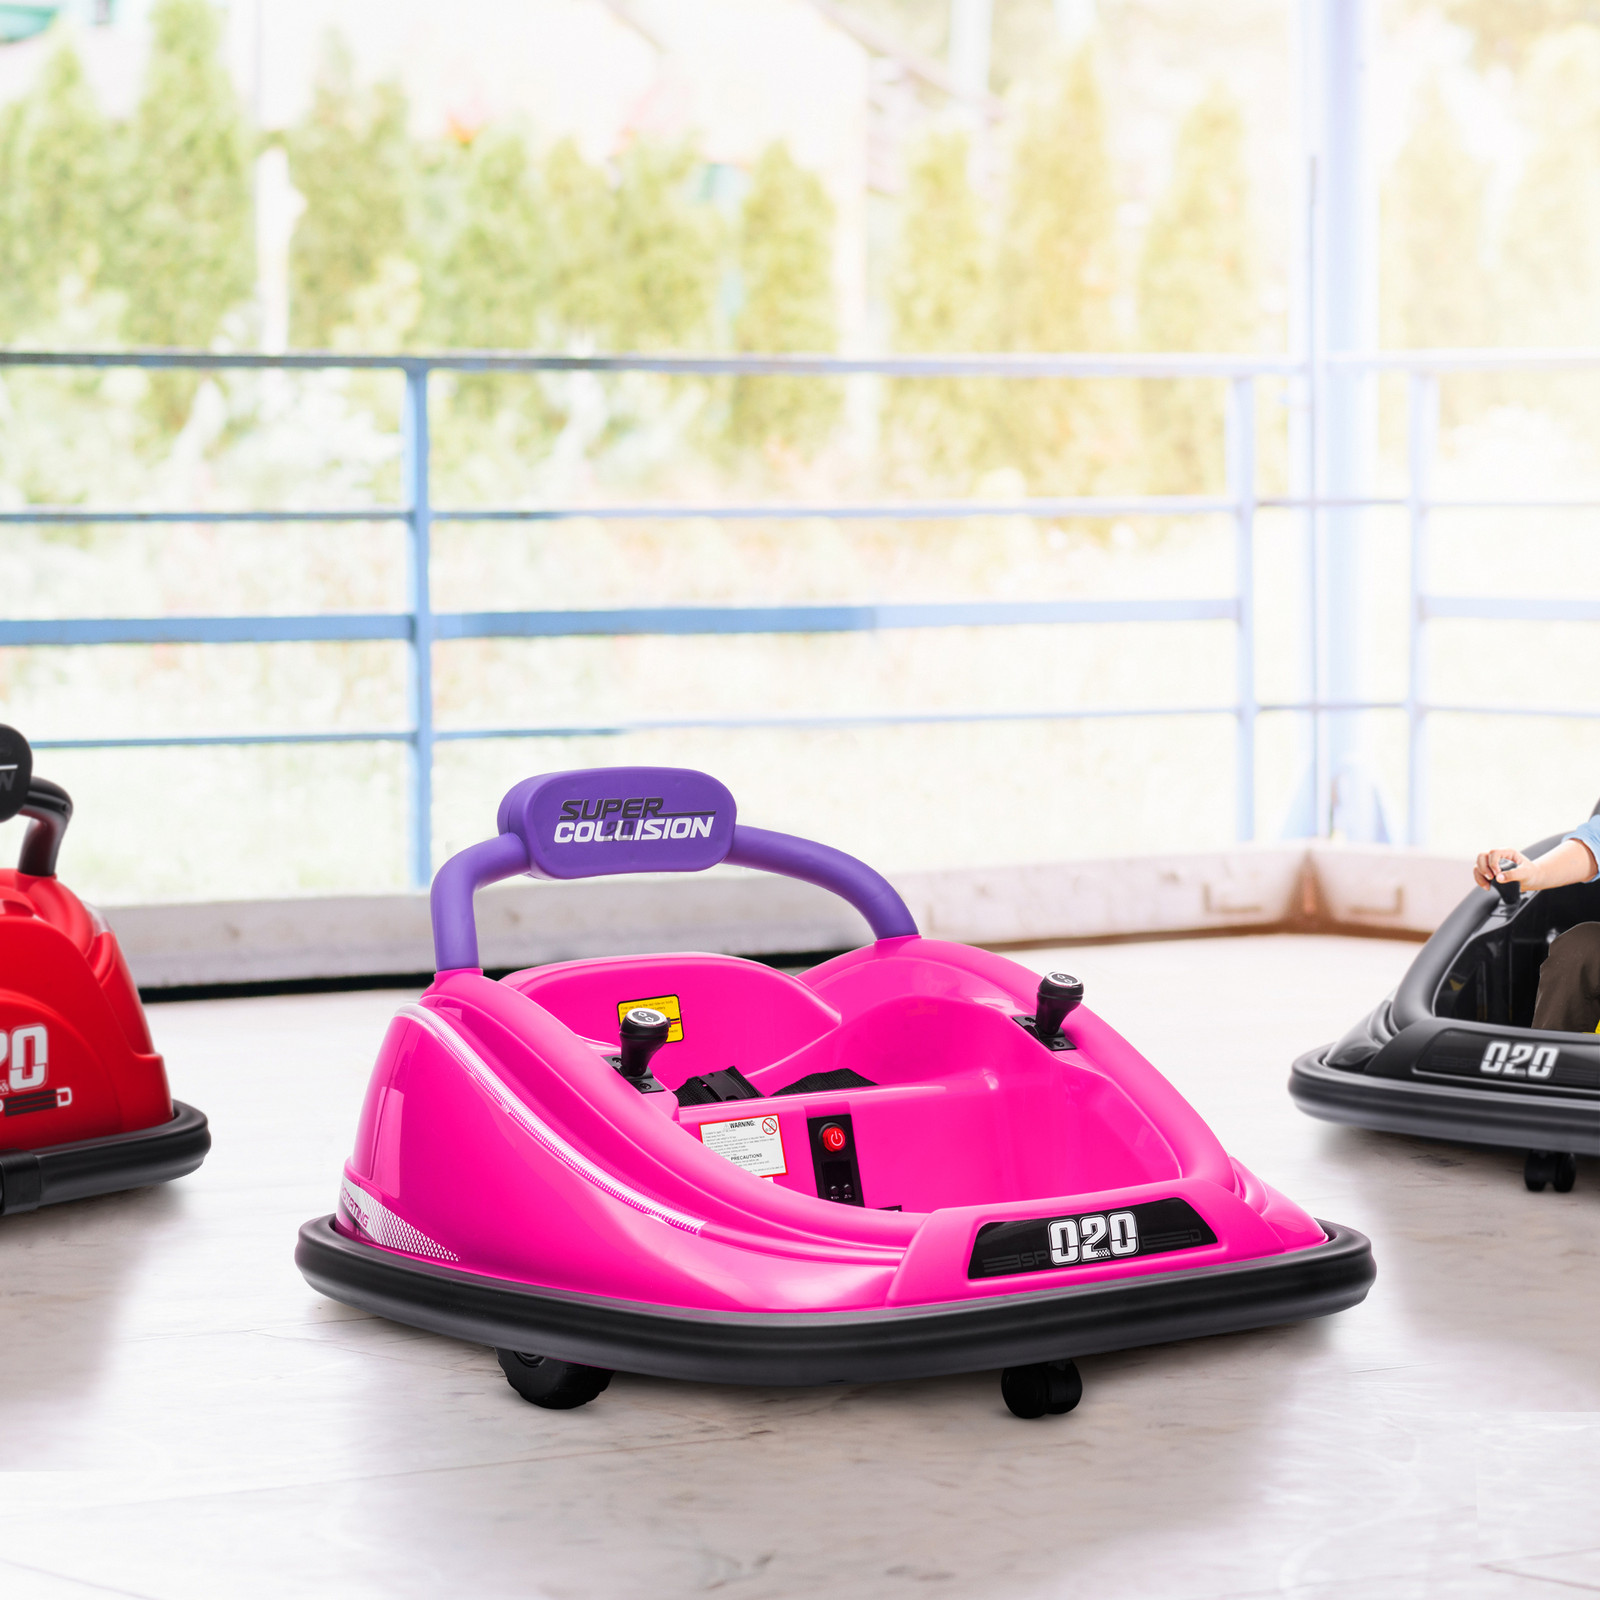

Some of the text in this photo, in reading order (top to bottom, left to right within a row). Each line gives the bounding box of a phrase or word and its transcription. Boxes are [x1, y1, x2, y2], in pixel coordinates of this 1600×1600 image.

[559, 797, 664, 821] SUPER
[553, 816, 715, 844] COLLISION
[0, 1023, 48, 1092] 0
[1480, 1040, 1560, 1079] 020
[730, 1153, 763, 1161] PRECAUTIONS
[1048, 1210, 1139, 1266] 020
